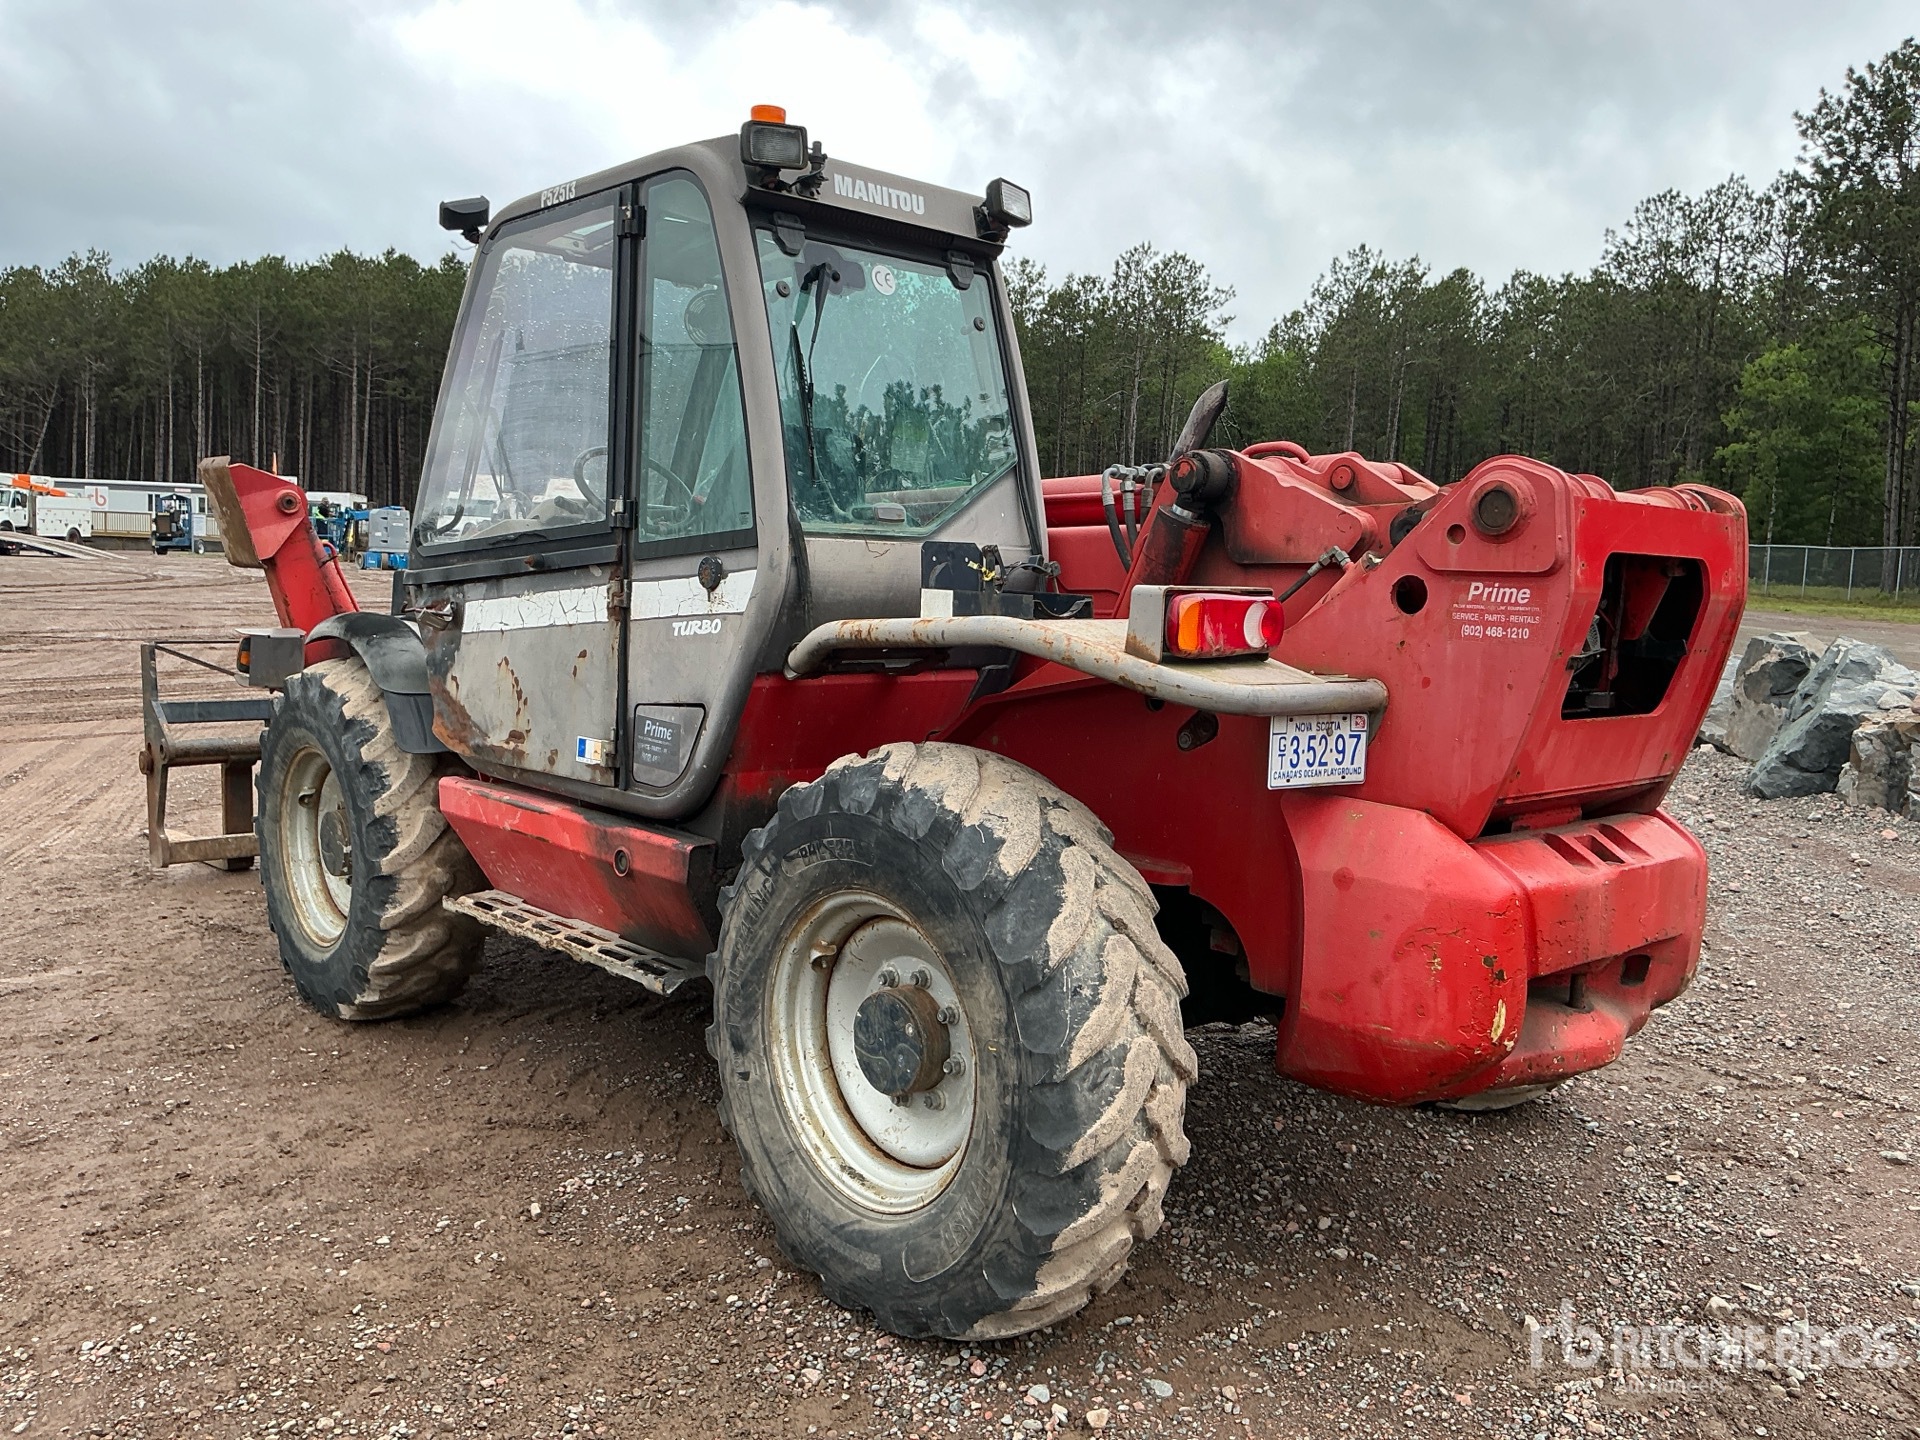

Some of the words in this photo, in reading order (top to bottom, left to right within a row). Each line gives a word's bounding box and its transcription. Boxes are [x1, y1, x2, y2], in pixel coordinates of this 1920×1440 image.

[833, 173, 925, 215] MANITOU
[874, 271, 893, 289] CE
[1467, 582, 1531, 604] Prime
[672, 618, 721, 636] TURBO
[1452, 612, 1479, 621] SERVICE
[1484, 614, 1505, 622] PARTS
[1510, 615, 1540, 624] RENTALS
[1461, 624, 1483, 638] (902)
[1485, 626, 1530, 639] 468-1210
[644, 720, 673, 740] Prime
[1295, 722, 1312, 732] NOVA
[1316, 721, 1341, 732] SCOTIA
[1273, 769, 1302, 780] CANADA'S
[1304, 768, 1322, 778] OCEAN
[1323, 766, 1362, 777] PLAYGROUND
